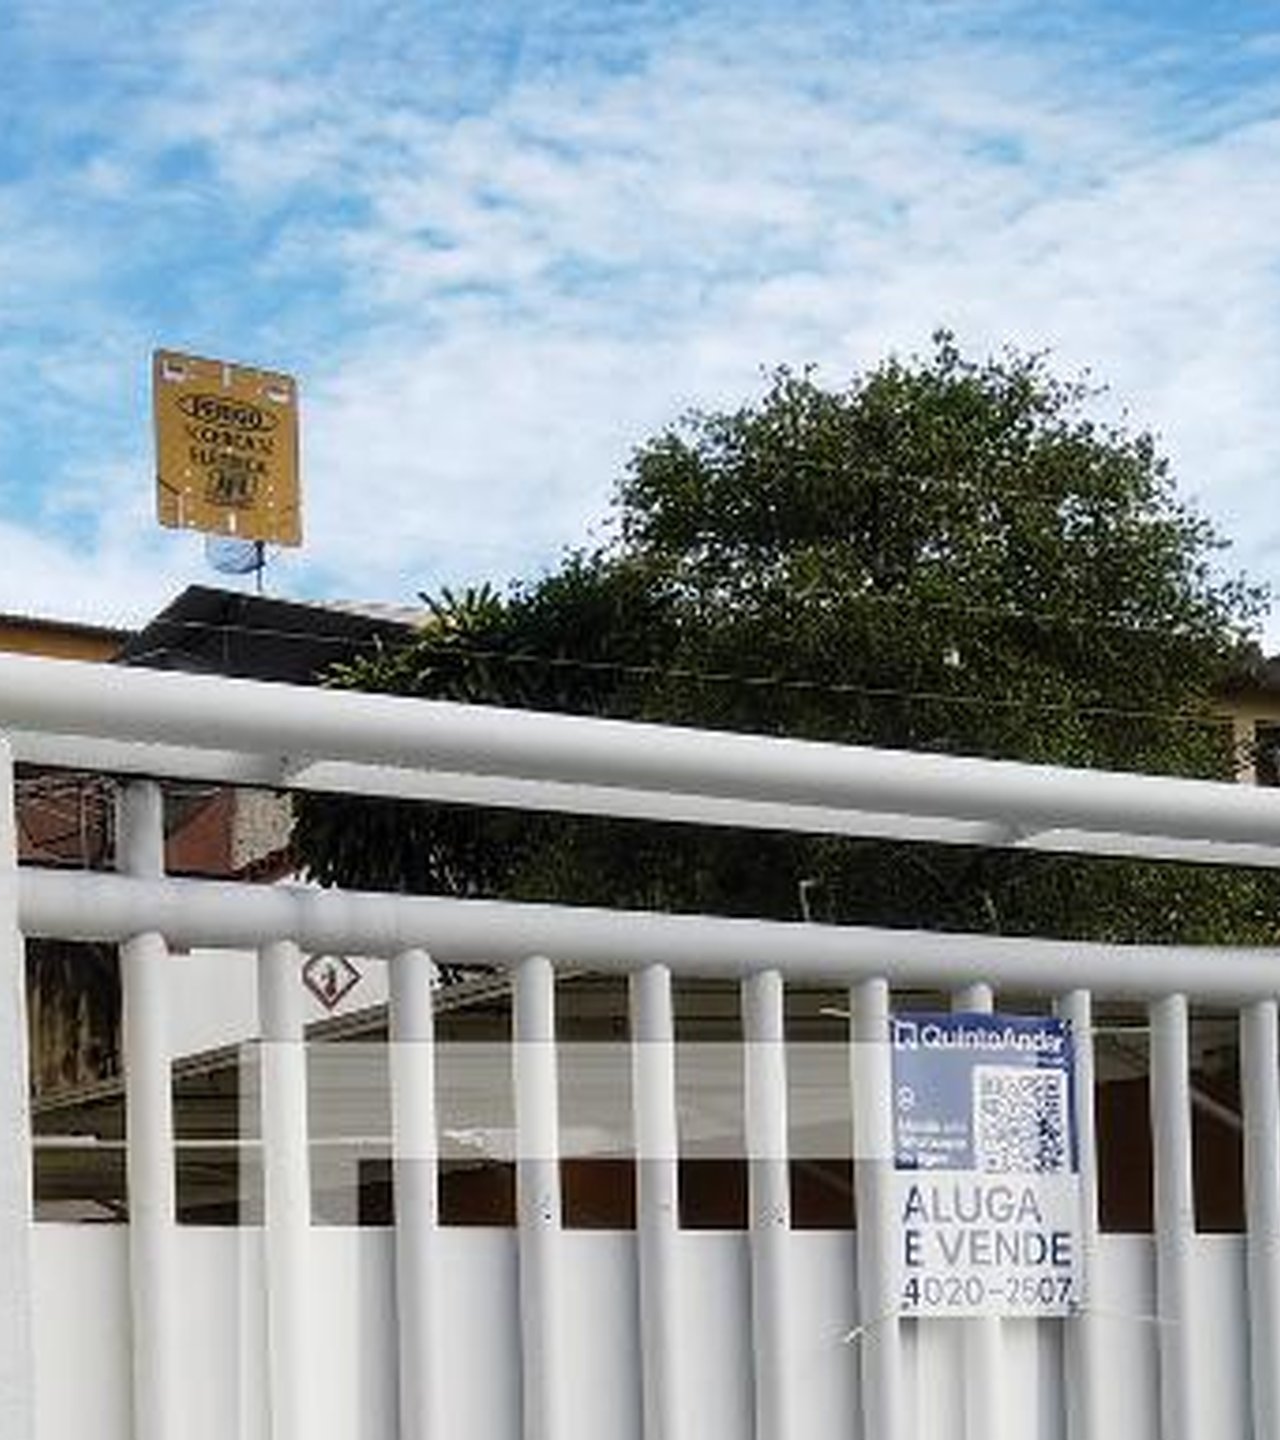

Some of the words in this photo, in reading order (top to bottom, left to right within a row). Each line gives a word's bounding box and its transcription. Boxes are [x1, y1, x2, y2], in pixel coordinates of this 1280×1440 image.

[902, 1184, 1042, 1224] ALUGA
[905, 1229, 923, 1266] E
[936, 1229, 1072, 1267] VENDE
[902, 1276, 1073, 1306] 4020-2507
